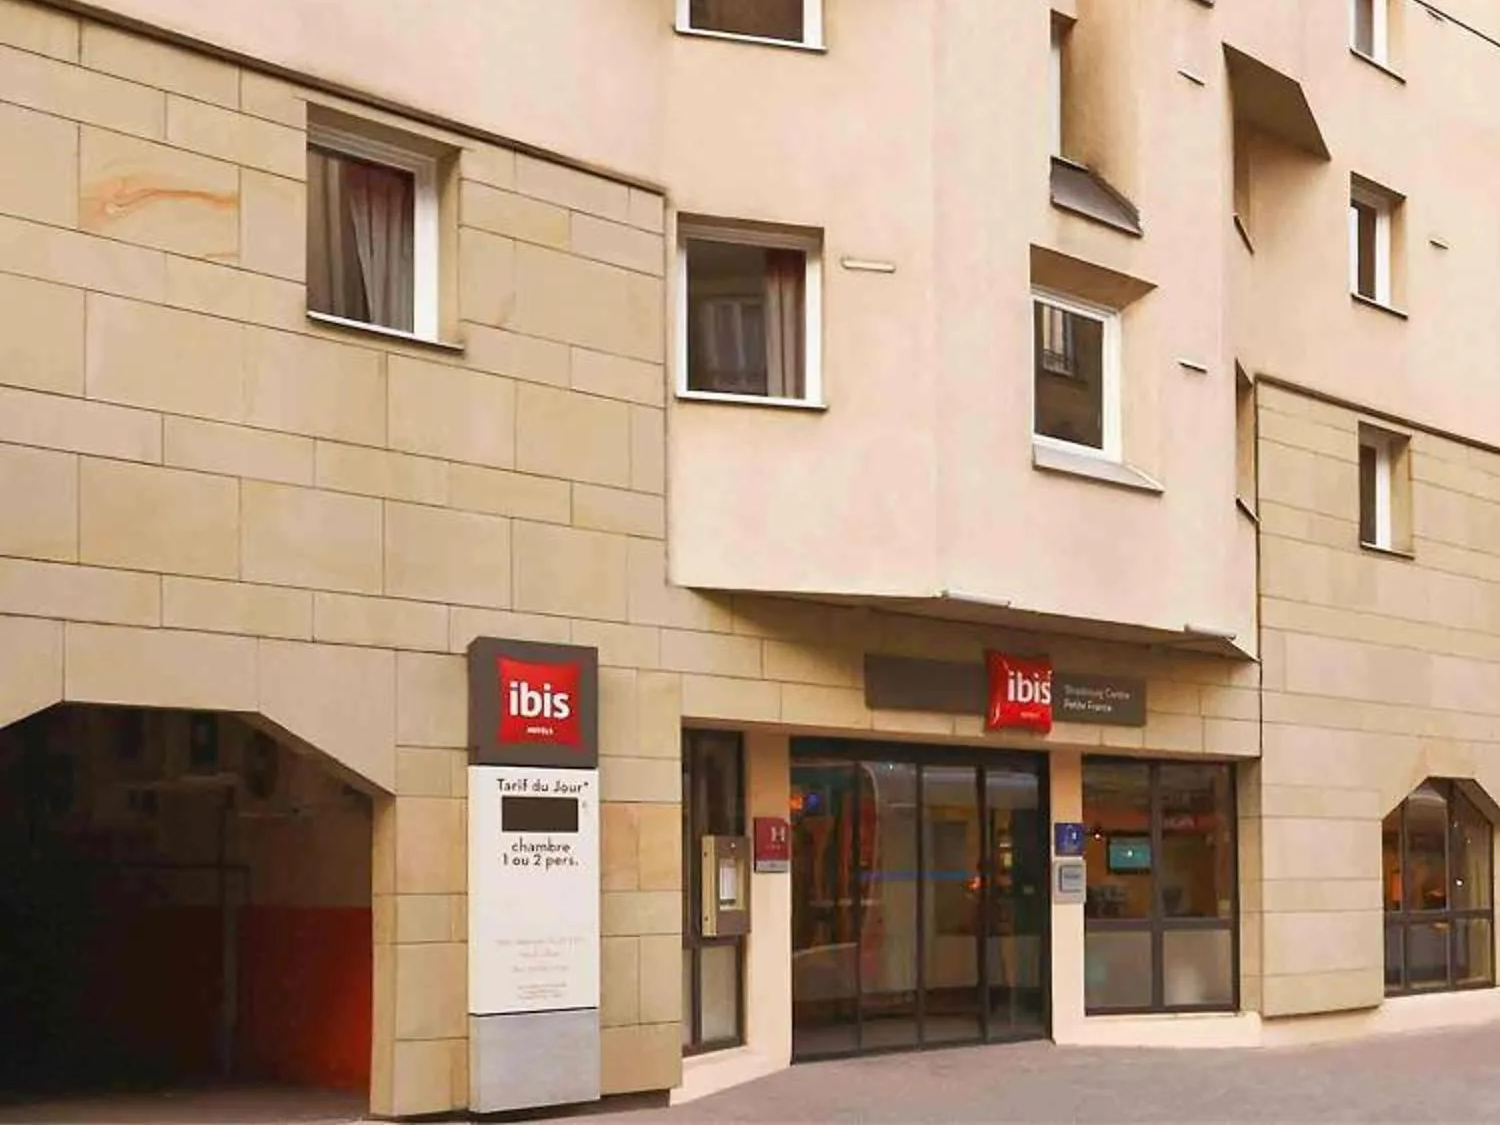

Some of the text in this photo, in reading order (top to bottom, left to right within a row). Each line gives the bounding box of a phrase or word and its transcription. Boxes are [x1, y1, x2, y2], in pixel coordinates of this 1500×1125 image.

[1007, 670, 1051, 704] ibis
[509, 680, 570, 719] ibis
[496, 778, 527, 792] Tarif
[532, 778, 548, 792] du
[771, 826, 785, 842] H
[511, 836, 570, 852] chambre
[512, 857, 529, 866] ou
[533, 854, 541, 866] 2
